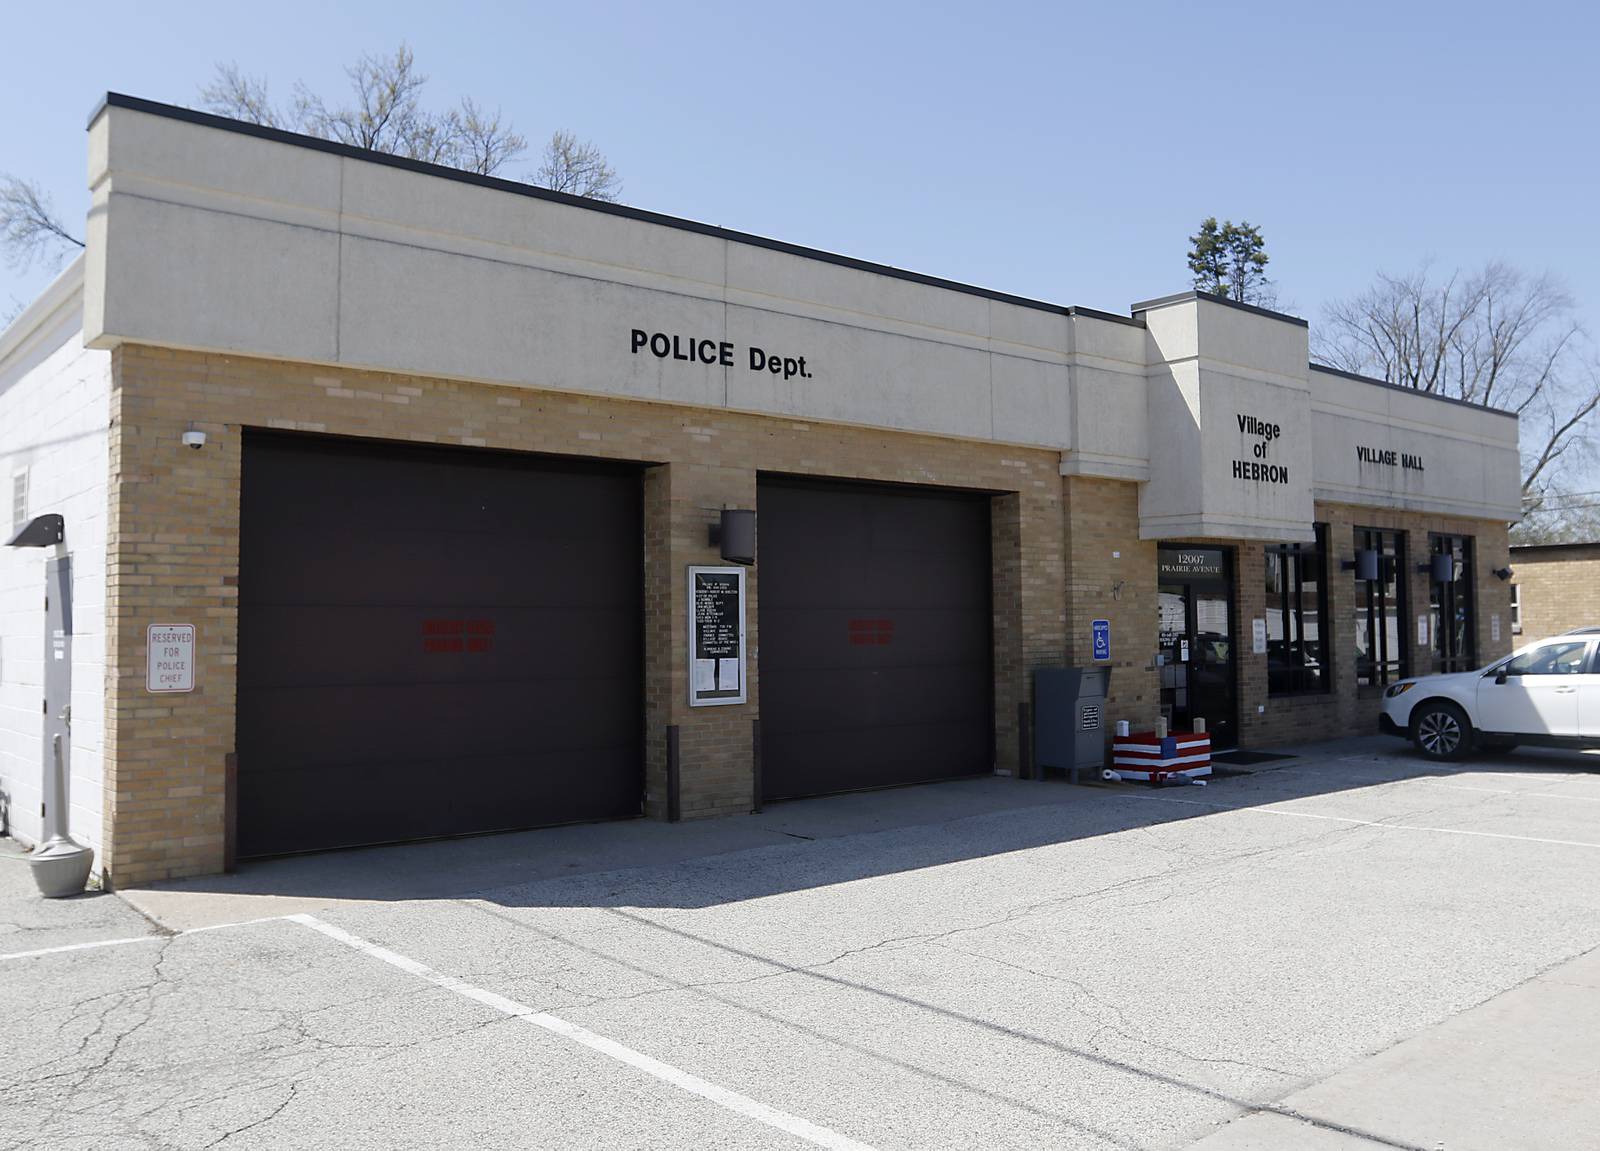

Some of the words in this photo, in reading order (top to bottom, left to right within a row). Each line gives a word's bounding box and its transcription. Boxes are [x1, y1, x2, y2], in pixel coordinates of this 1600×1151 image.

[631, 328, 734, 367] POLICE
[749, 346, 812, 380] Dept.
[1237, 414, 1280, 441] Village
[1253, 442, 1267, 459] of
[1356, 446, 1398, 466] VILLAGE
[1401, 453, 1424, 471] HALL
[1232, 460, 1288, 484] HEBRON
[1178, 554, 1205, 565] 12007
[1161, 564, 1191, 573] PRAIRIE
[1192, 565, 1219, 574] AVENUE
[152, 633, 192, 643] RESERVED
[163, 647, 180, 657] FOR
[157, 661, 185, 670] POLICE
[160, 674, 182, 683] CHIEF
